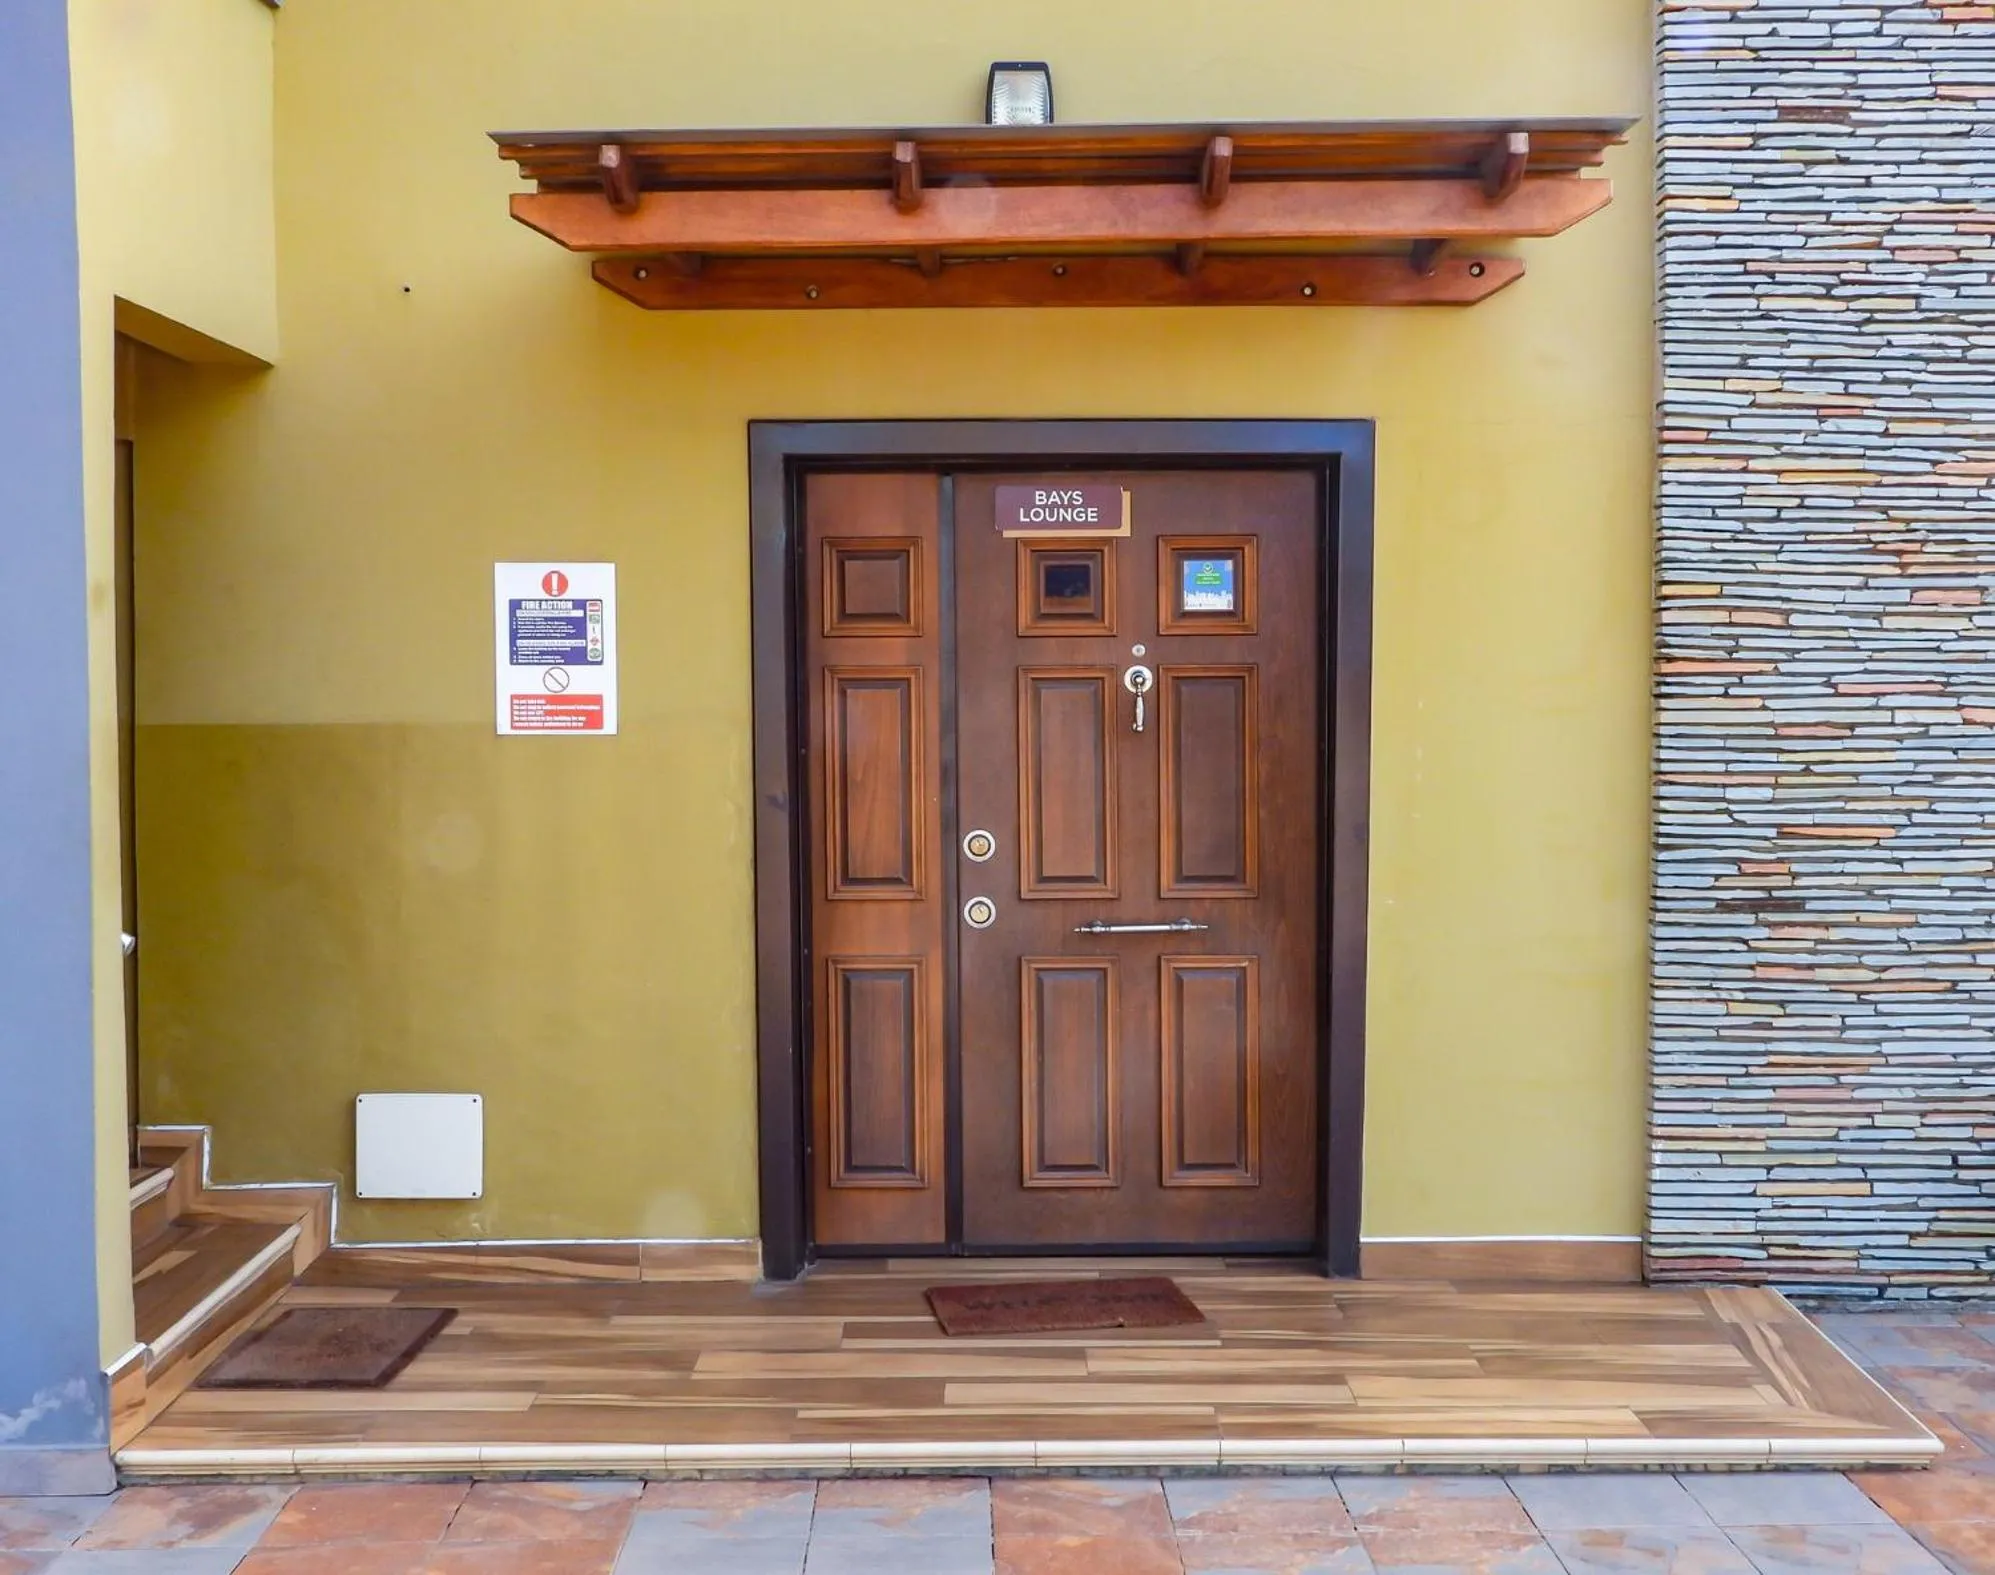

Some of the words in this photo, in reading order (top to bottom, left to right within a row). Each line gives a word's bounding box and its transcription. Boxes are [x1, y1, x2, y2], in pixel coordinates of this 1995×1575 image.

[1035, 490, 1083, 505] BAYS
[1019, 507, 1098, 522] LOUNGE
[521, 600, 540, 610] FIRE
[541, 600, 573, 610] ACTION
